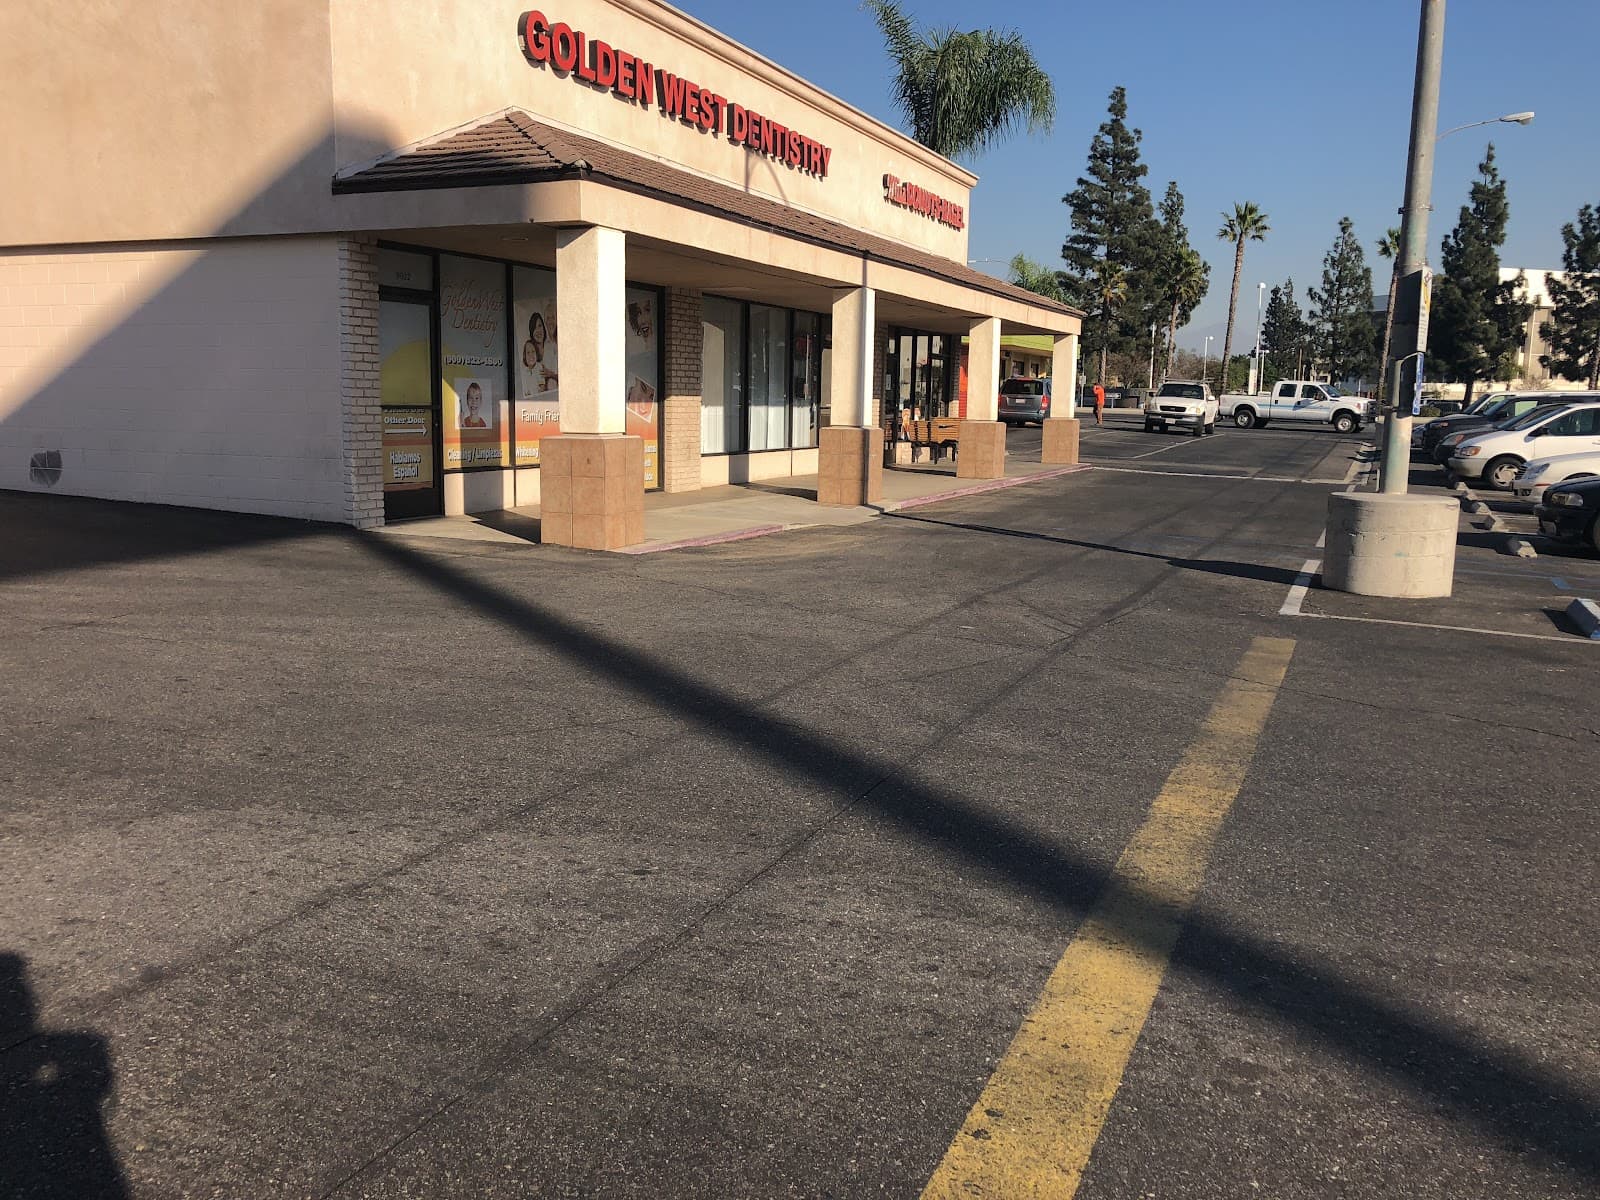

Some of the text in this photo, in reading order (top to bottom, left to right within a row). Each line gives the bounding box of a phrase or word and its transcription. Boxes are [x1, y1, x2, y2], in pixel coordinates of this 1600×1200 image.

[520, 10, 832, 177] GOLDEN WEST DENTISTRY
[453, 308, 498, 349] Dentistry
[384, 416, 425, 425] Other Door
[521, 408, 544, 425] Family
[389, 451, 421, 465] Hablamos
[393, 465, 418, 480] Español
